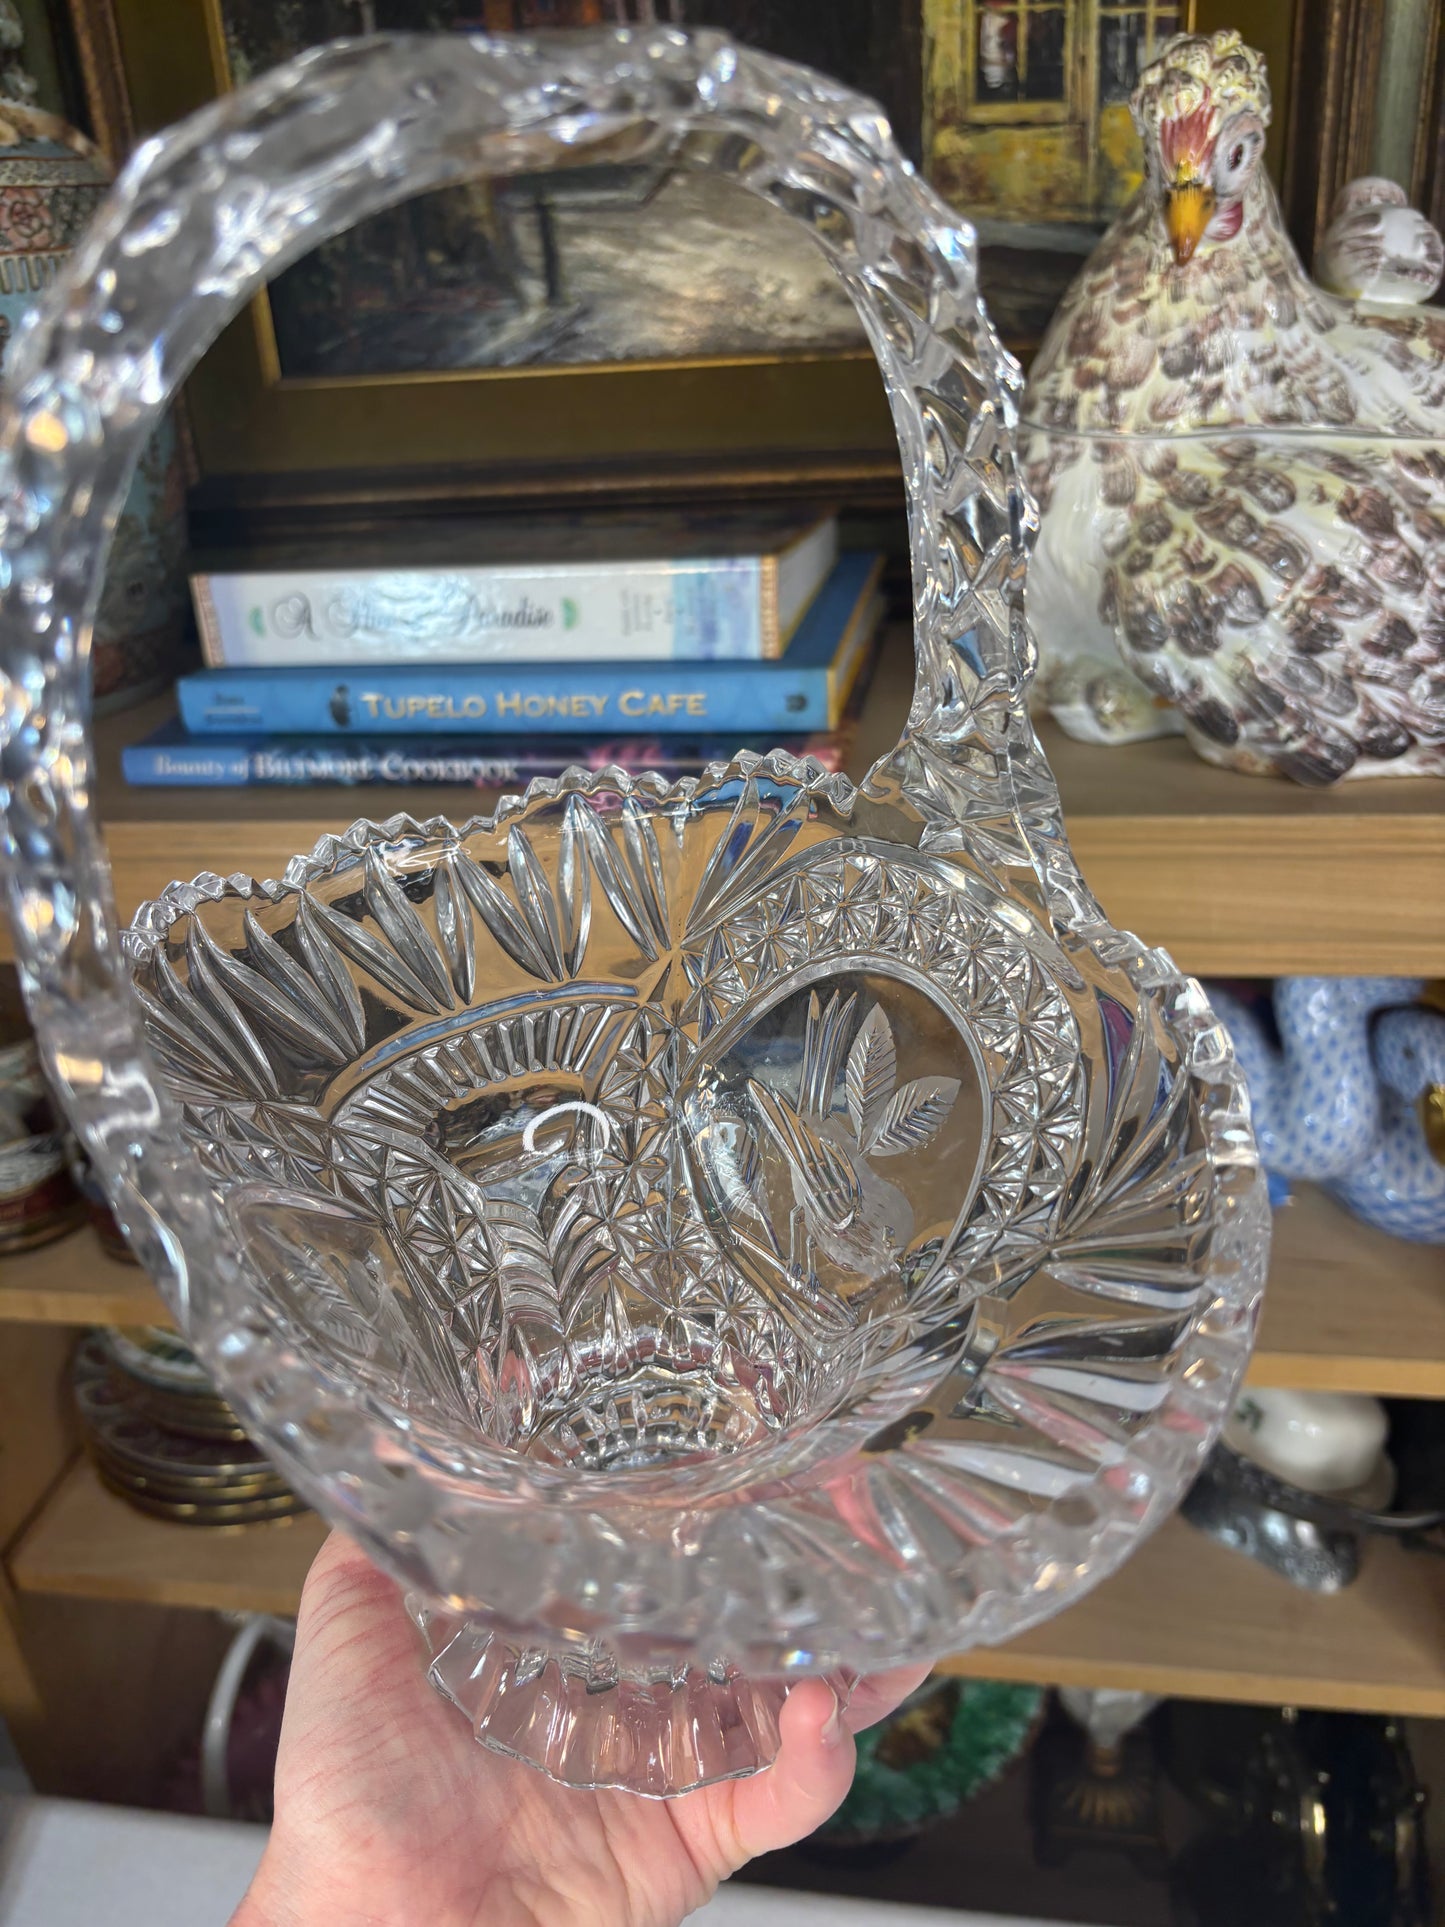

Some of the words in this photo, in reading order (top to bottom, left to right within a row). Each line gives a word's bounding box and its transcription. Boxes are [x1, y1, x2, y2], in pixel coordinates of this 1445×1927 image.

[362, 691, 487, 720] TUPELO
[495, 691, 610, 718] HONEY
[617, 690, 708, 717] CAFE
